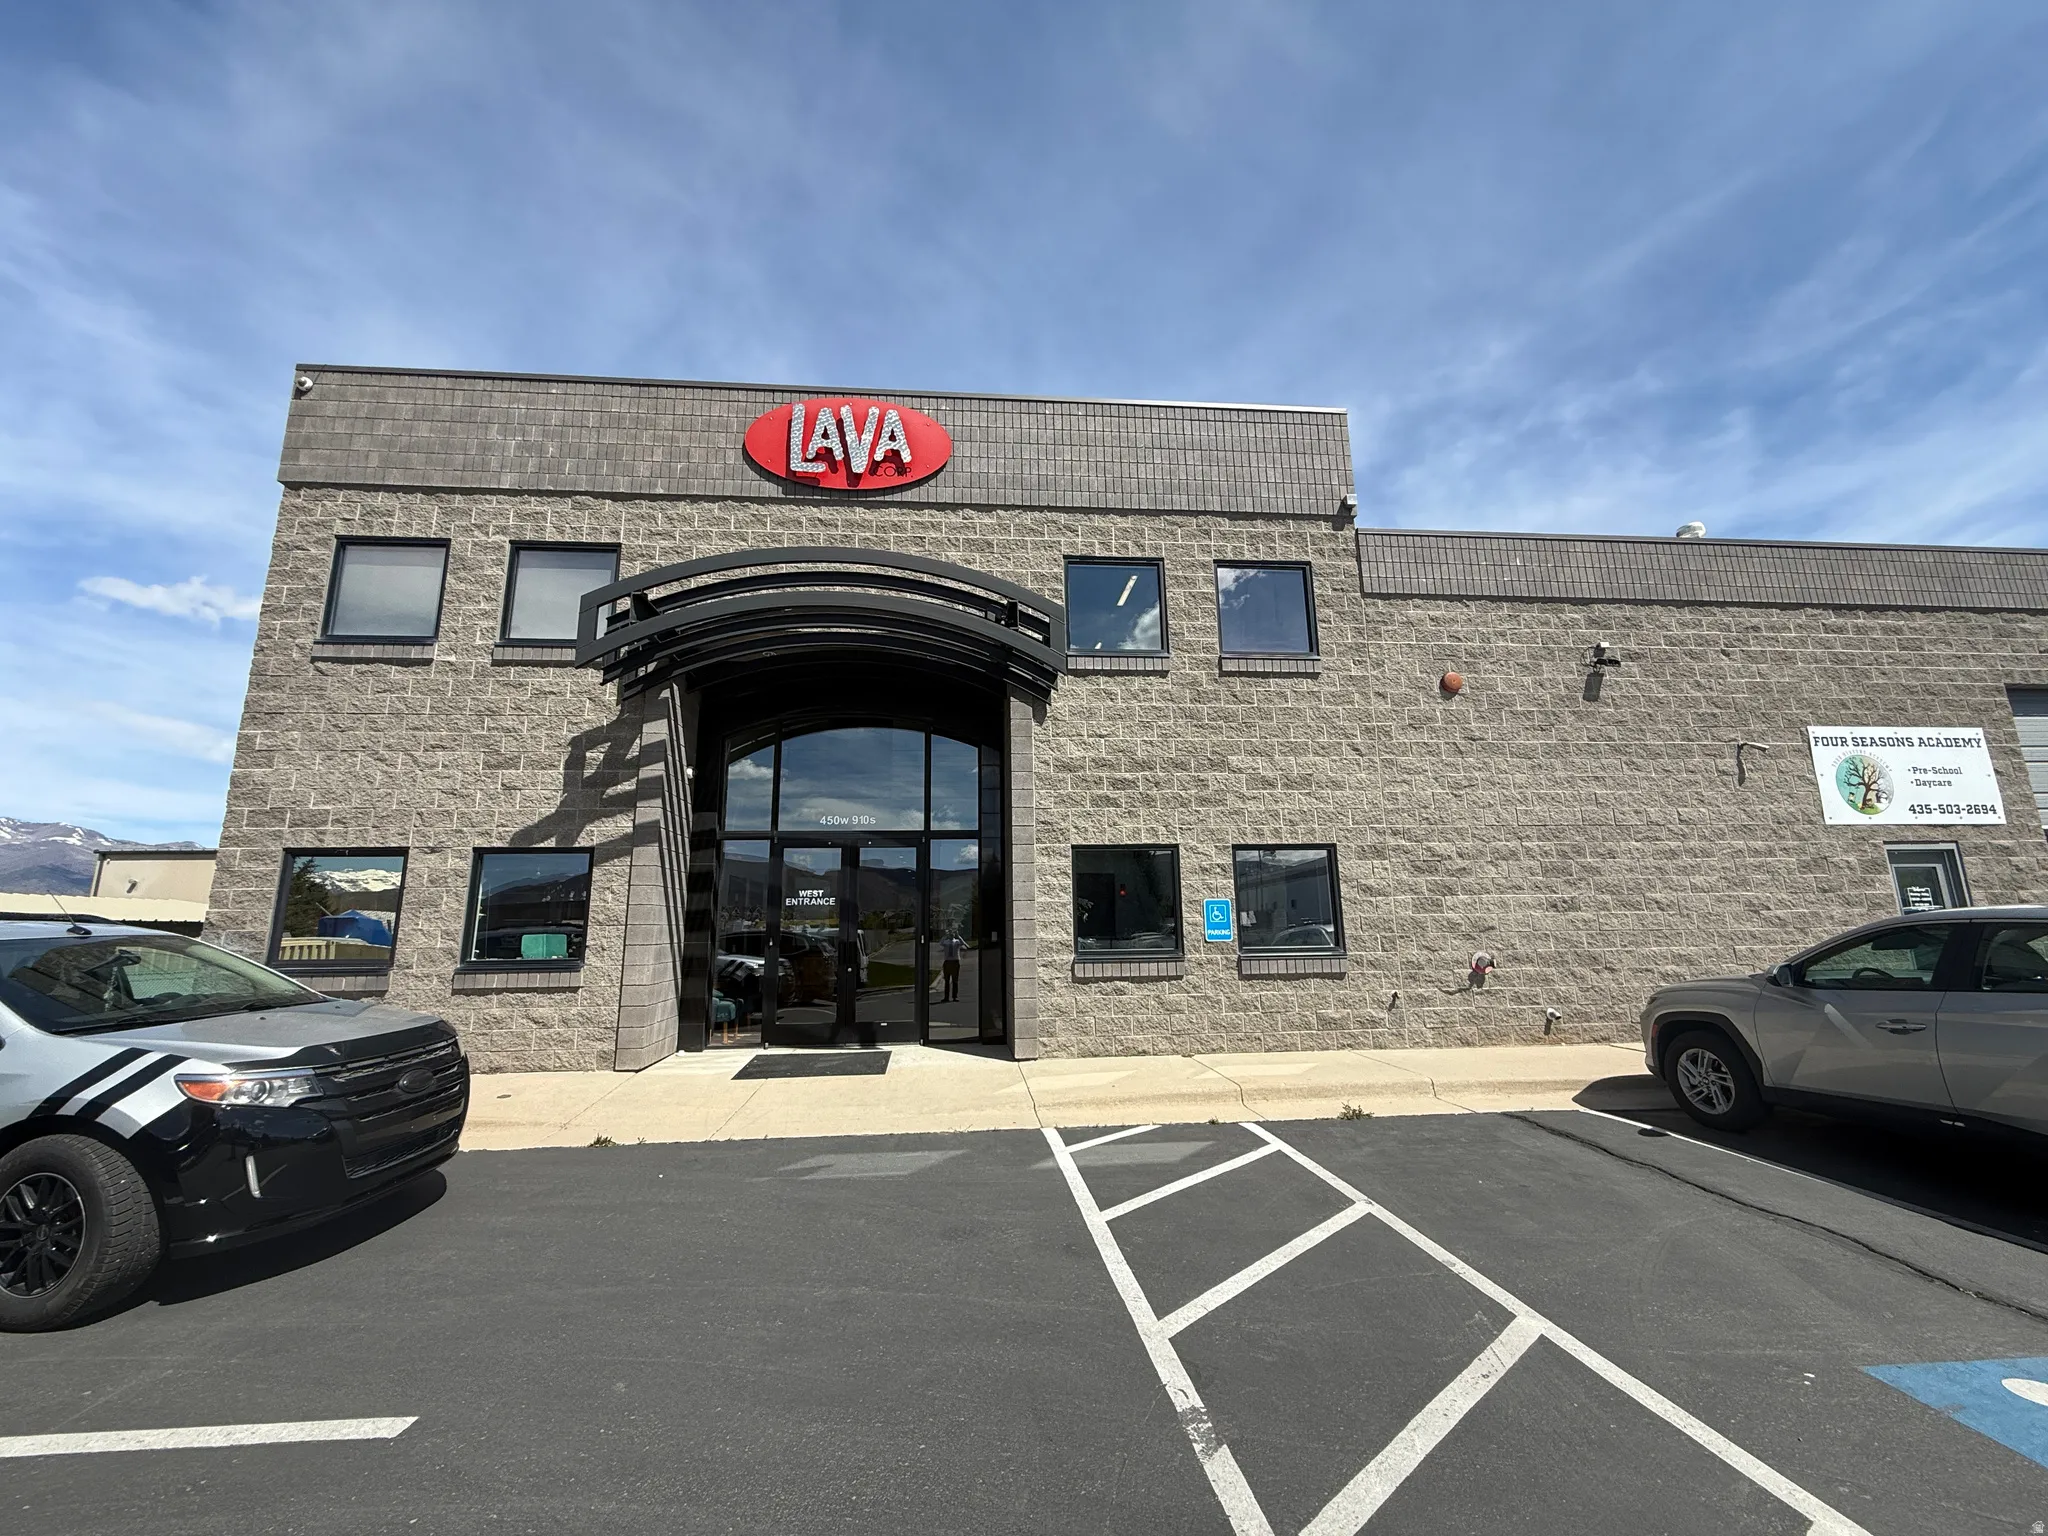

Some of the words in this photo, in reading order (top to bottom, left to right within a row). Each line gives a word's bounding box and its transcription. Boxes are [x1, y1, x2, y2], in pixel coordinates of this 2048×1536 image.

[789, 402, 913, 474] LAVA
[1813, 736, 1850, 748] FOUR
[1851, 736, 1915, 748] SEASONS
[1917, 736, 1983, 749] ACADEMY
[1908, 803, 1998, 815] 435-503-2694
[819, 815, 849, 825] 450w
[852, 815, 876, 825] 910s
[798, 889, 825, 898] WEST
[785, 897, 836, 906] ENTRANCE
[1207, 928, 1231, 936] PARKING
